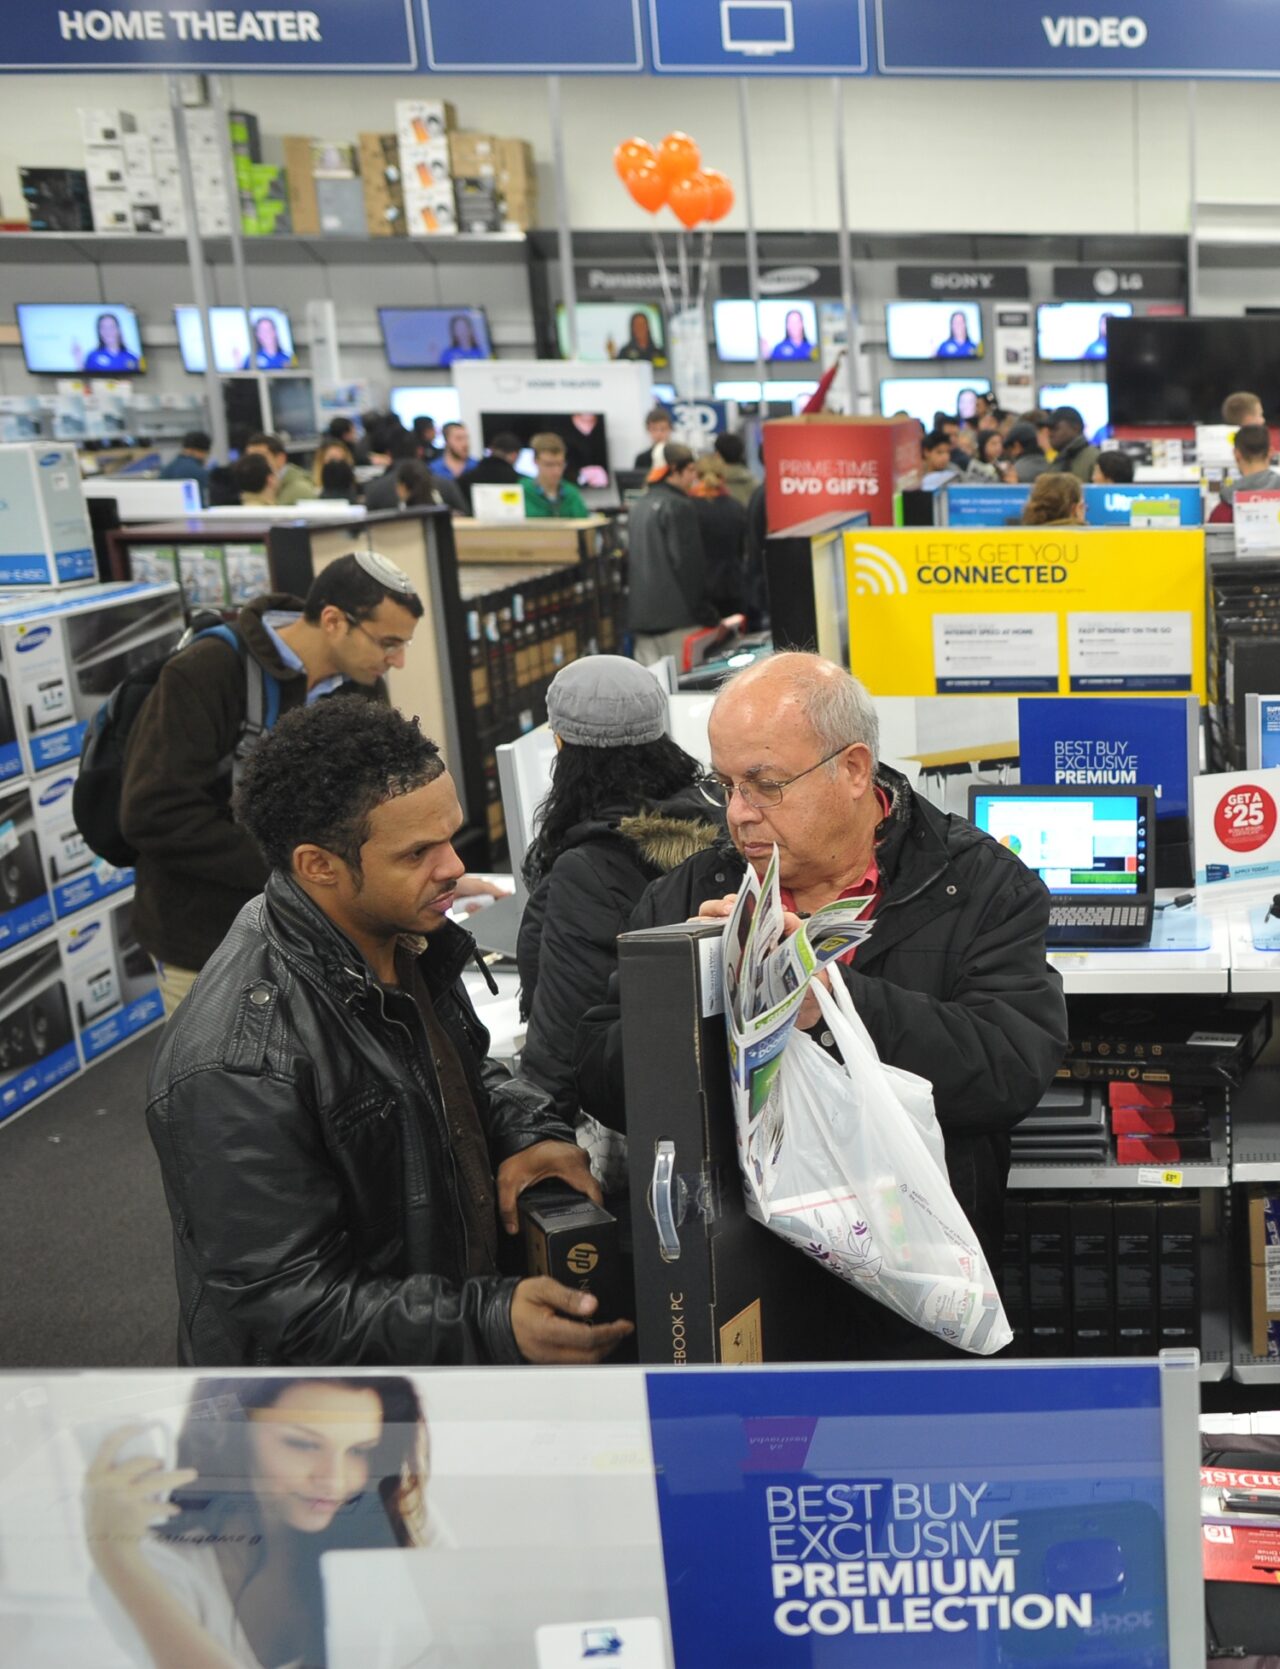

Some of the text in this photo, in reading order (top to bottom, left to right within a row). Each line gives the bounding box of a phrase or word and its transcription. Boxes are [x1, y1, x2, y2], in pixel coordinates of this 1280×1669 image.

[58, 10, 322, 41] HOME THEATER
[1041, 16, 1148, 48] VIDEO
[930, 273, 995, 289] SONY
[1119, 274, 1143, 290] LG
[673, 404, 718, 431] 3D
[780, 459, 879, 476] PRIME TIME
[780, 477, 880, 496] DVD GIFTS
[914, 543, 1080, 565] LET'S GET YOU
[916, 565, 1069, 585] CONNECTED
[1054, 741, 1128, 755] BEST BUY
[1054, 755, 1138, 770] EXCLUSIVE
[1054, 770, 1137, 785] PREMIUM
[1227, 792, 1262, 806] GET A
[1223, 802, 1265, 828] $25
[566, 1243, 599, 1274] hp
[670, 1292, 687, 1367] EBOOK PC
[766, 1481, 988, 1524] BEST BUY
[768, 1519, 1021, 1561] EXCLUSIVE
[771, 1557, 1016, 1599] PREMIUM
[773, 1592, 1093, 1636] COLLECTION
